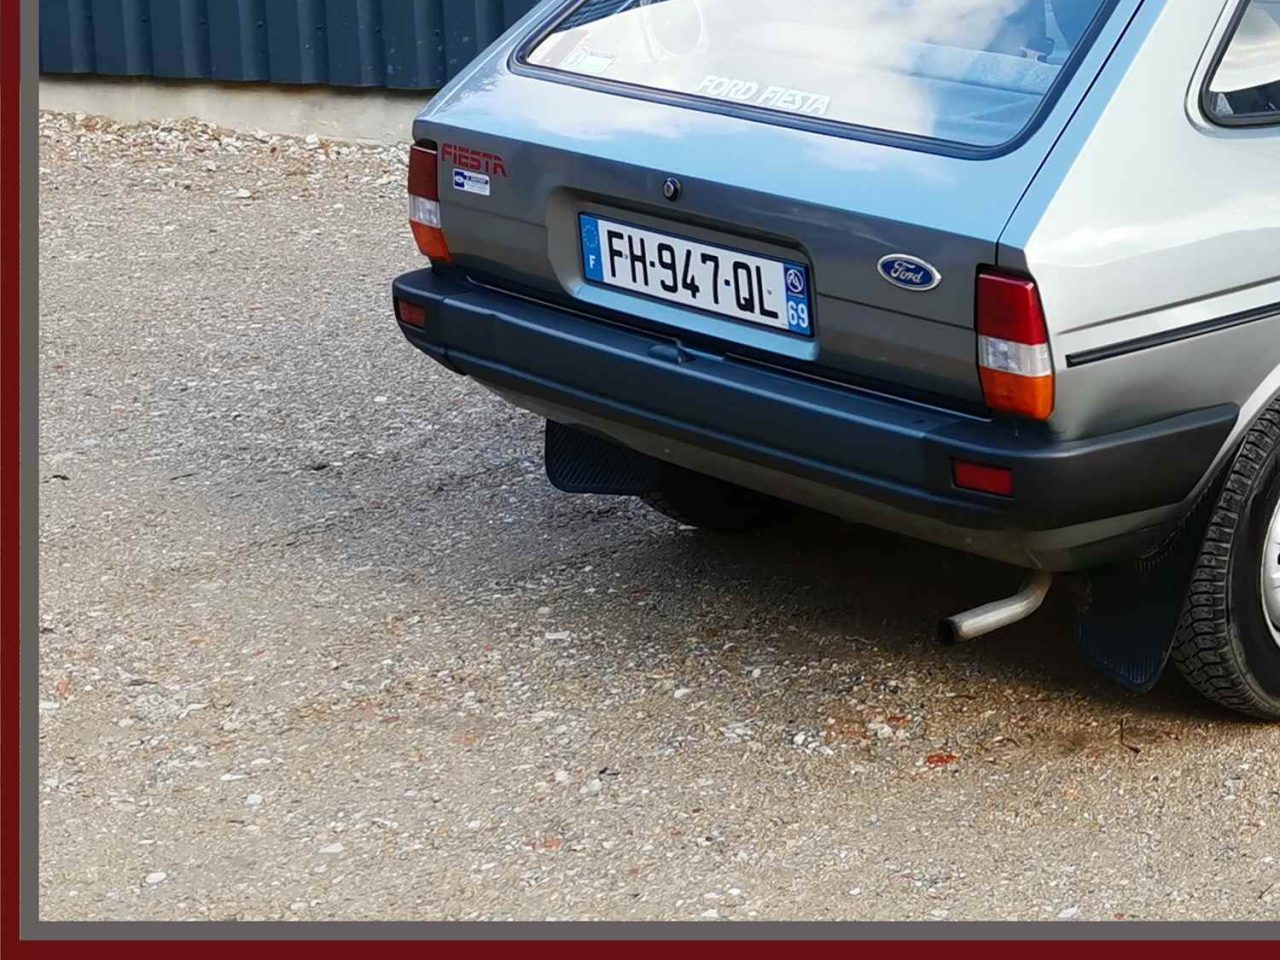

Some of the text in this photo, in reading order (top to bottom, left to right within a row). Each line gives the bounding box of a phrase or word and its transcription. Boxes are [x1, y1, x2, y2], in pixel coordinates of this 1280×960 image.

[696, 74, 831, 116] FORD FIESTA
[441, 142, 507, 177] FIESTA
[588, 254, 597, 270] F
[890, 260, 924, 284] Ford
[787, 300, 809, 329] 69
